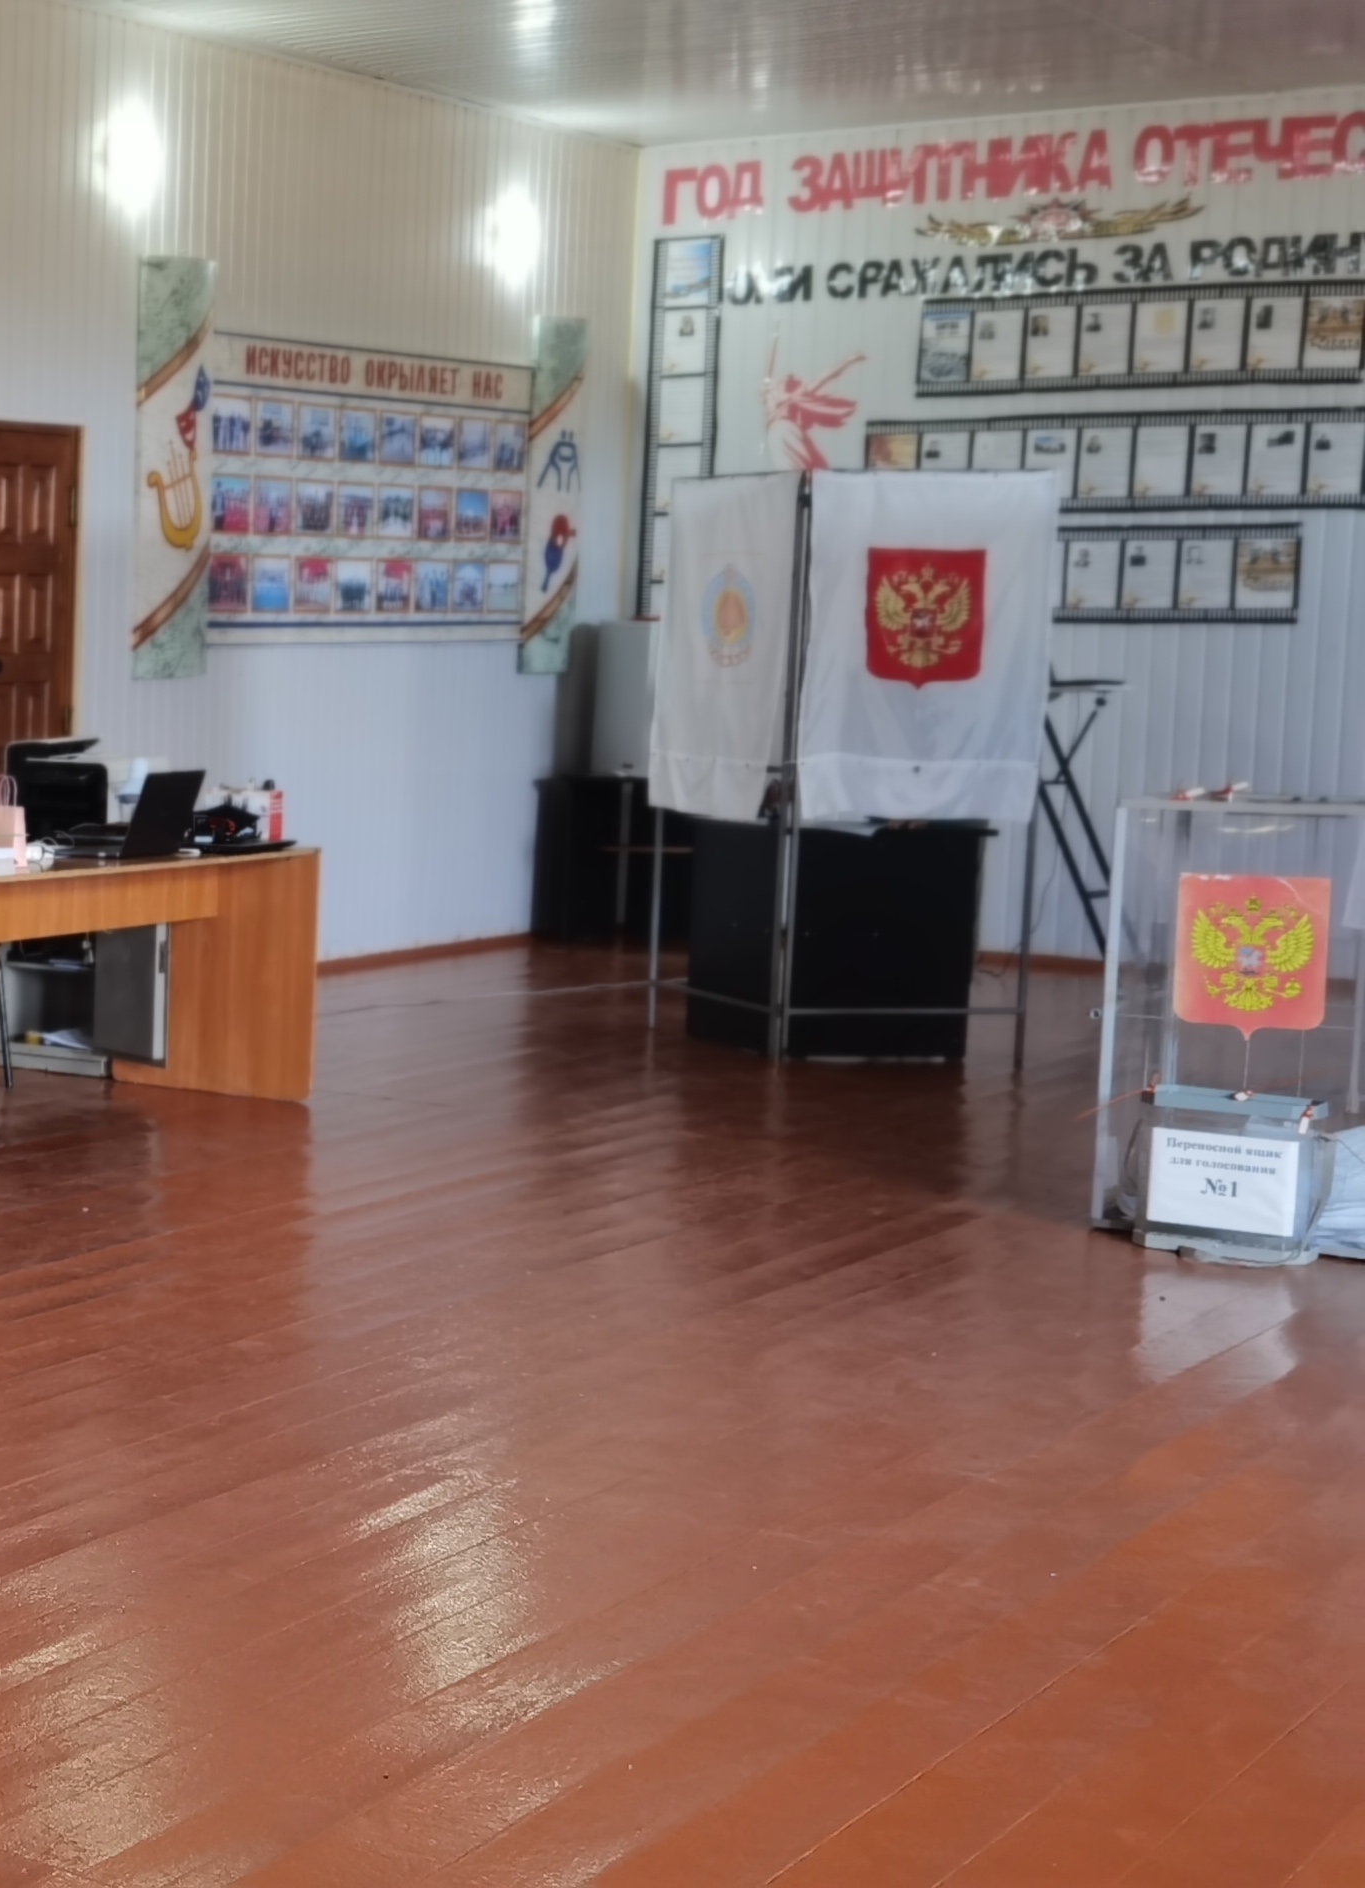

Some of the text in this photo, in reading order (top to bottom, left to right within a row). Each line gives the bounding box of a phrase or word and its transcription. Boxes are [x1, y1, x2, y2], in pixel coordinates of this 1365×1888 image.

[662, 161, 765, 226] ГОД
[787, 129, 1115, 213] ЗАЩИТНИКА
[1112, 241, 1173, 284] ЗА
[1189, 231, 1365, 279] РОДИН
[244, 344, 505, 401] ИСКУССТВО ОКРЫЛЯЕТ НАС
[1166, 1137, 1284, 1160] Переносной ящик
[1169, 1156, 1277, 1176] для голосования
[1199, 1176, 1239, 1198] №1
